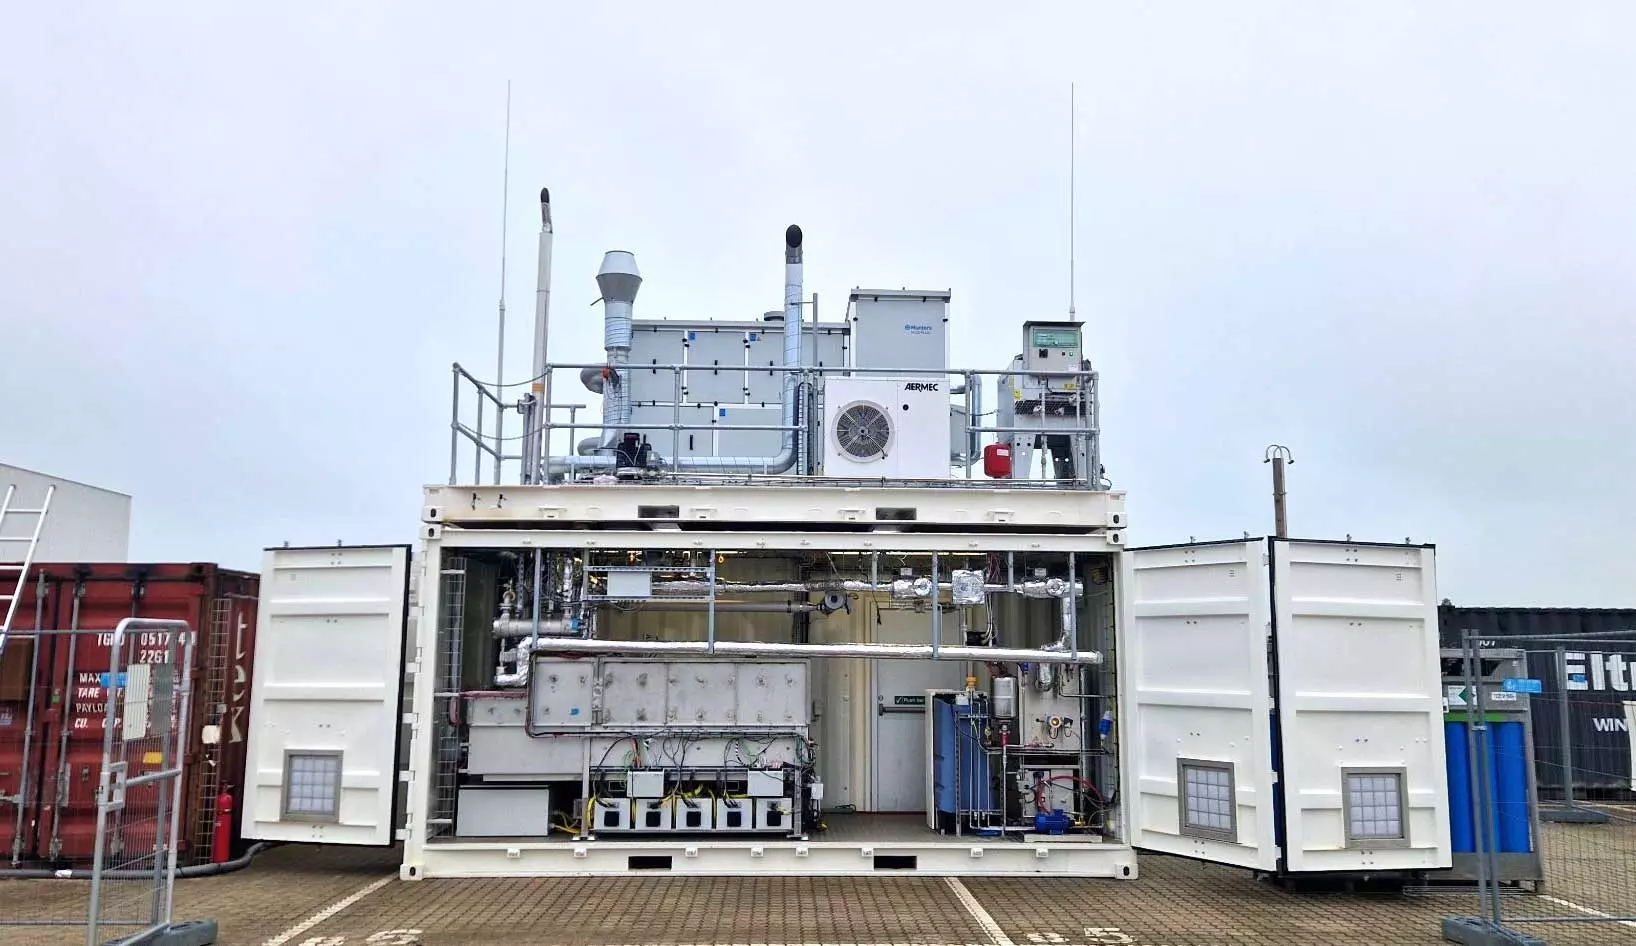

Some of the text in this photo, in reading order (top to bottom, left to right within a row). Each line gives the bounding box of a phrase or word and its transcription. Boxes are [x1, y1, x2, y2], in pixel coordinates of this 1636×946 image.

[904, 382, 939, 392] AERMEC
[139, 649, 169, 664] 22G1
[1556, 651, 1636, 692] Elt
[77, 687, 100, 699] TARE
[101, 717, 122, 729] CP.
